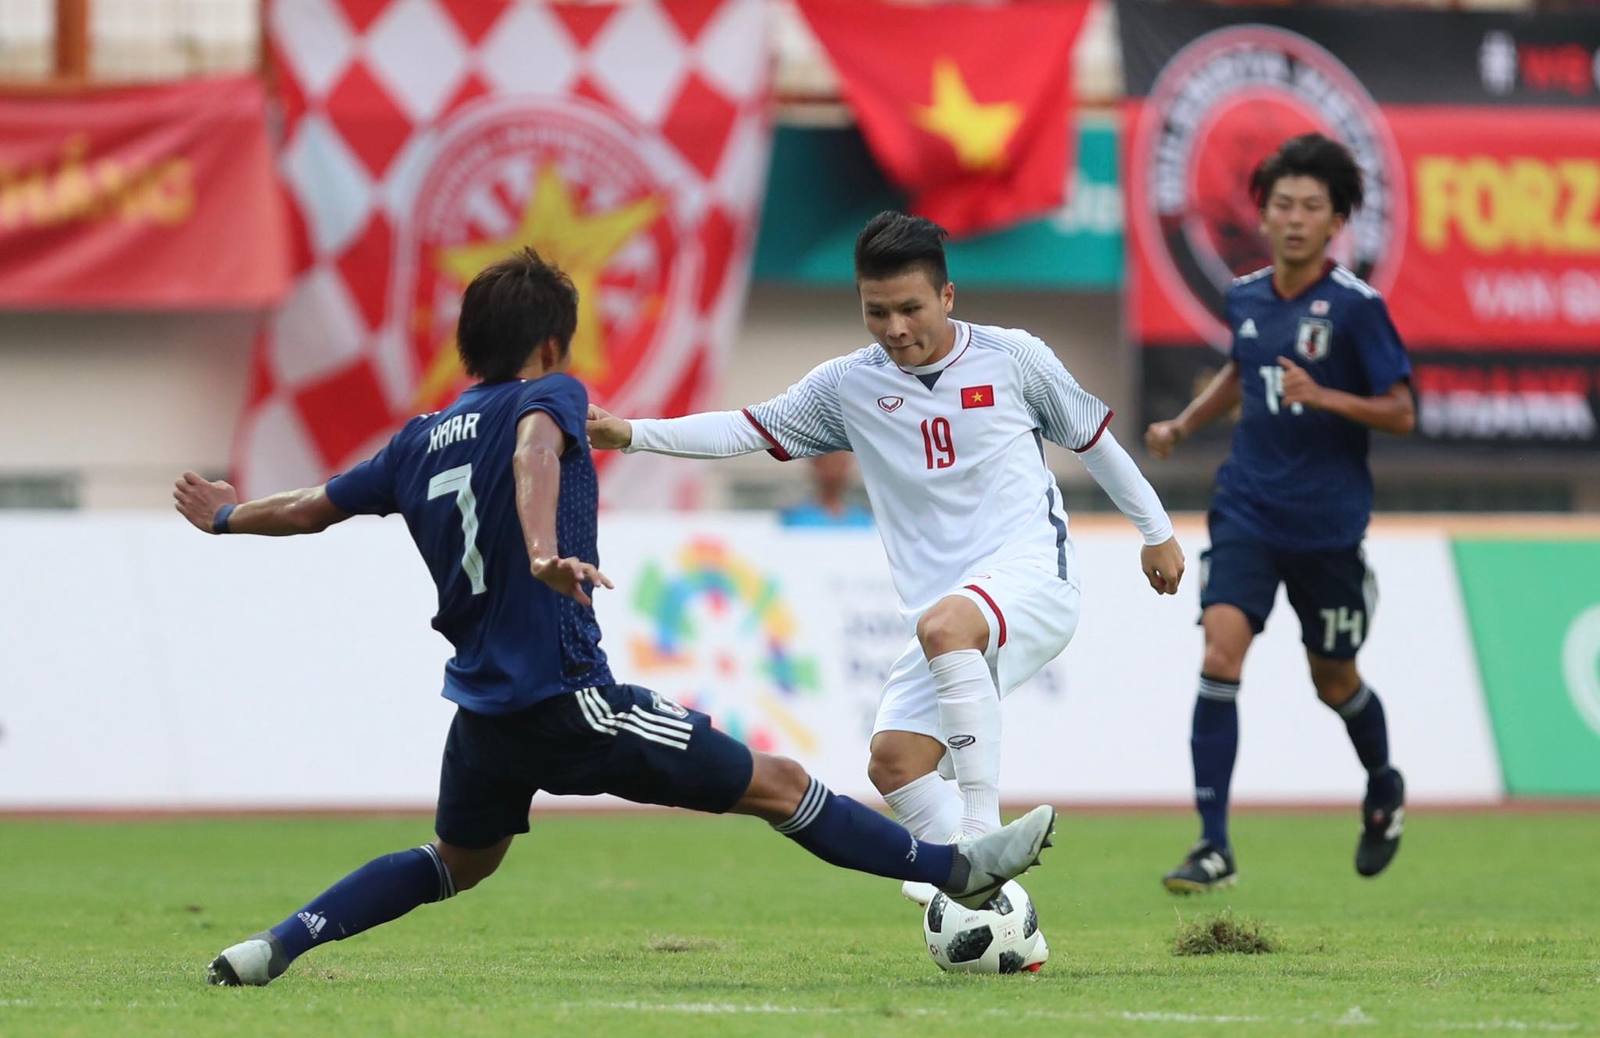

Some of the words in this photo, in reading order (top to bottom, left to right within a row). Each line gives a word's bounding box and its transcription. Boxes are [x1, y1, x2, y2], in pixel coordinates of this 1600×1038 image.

[920, 416, 956, 470] 19
[427, 463, 488, 595] 7
[1320, 606, 1362, 651] 14
